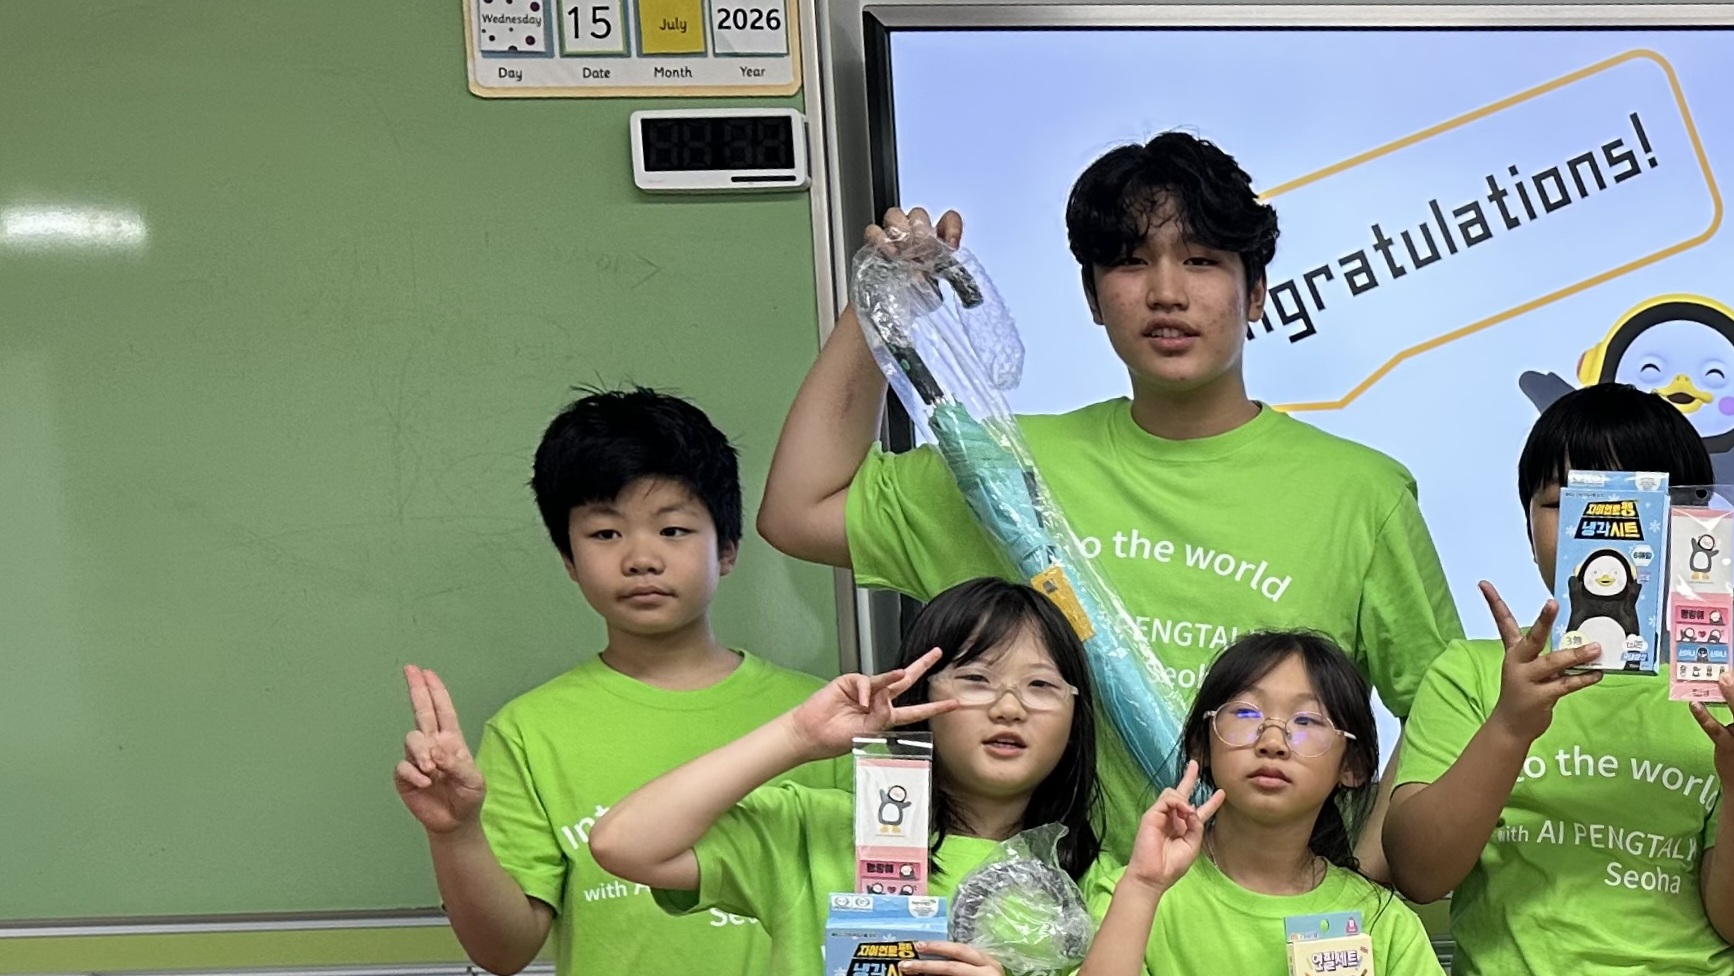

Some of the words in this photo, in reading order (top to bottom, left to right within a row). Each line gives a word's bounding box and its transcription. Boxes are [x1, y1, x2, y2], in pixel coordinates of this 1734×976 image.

[482, 14, 542, 27] Wednesday
[567, 6, 612, 39] 15
[659, 17, 688, 33] July
[717, 8, 781, 31] 2026
[498, 67, 523, 82] Day
[582, 67, 611, 79] Date
[653, 66, 693, 79] Month
[739, 65, 766, 78] Year
[1246, 112, 1658, 343] gratulations!
[1586, 502, 1636, 516] 자이언트펭
[1581, 521, 1640, 537] 냉각시트
[1112, 529, 1174, 562] the
[1185, 543, 1293, 602] world
[1133, 616, 1238, 651] ENGTA
[1555, 745, 1619, 778] the
[561, 804, 610, 850] In
[1537, 820, 1564, 845] AI
[1573, 822, 1697, 862] PENGTALK
[1604, 862, 1681, 894] Seoha
[583, 881, 628, 902] with
[857, 943, 915, 958] 자이언트펭
[1312, 950, 1360, 972] 연필세트
